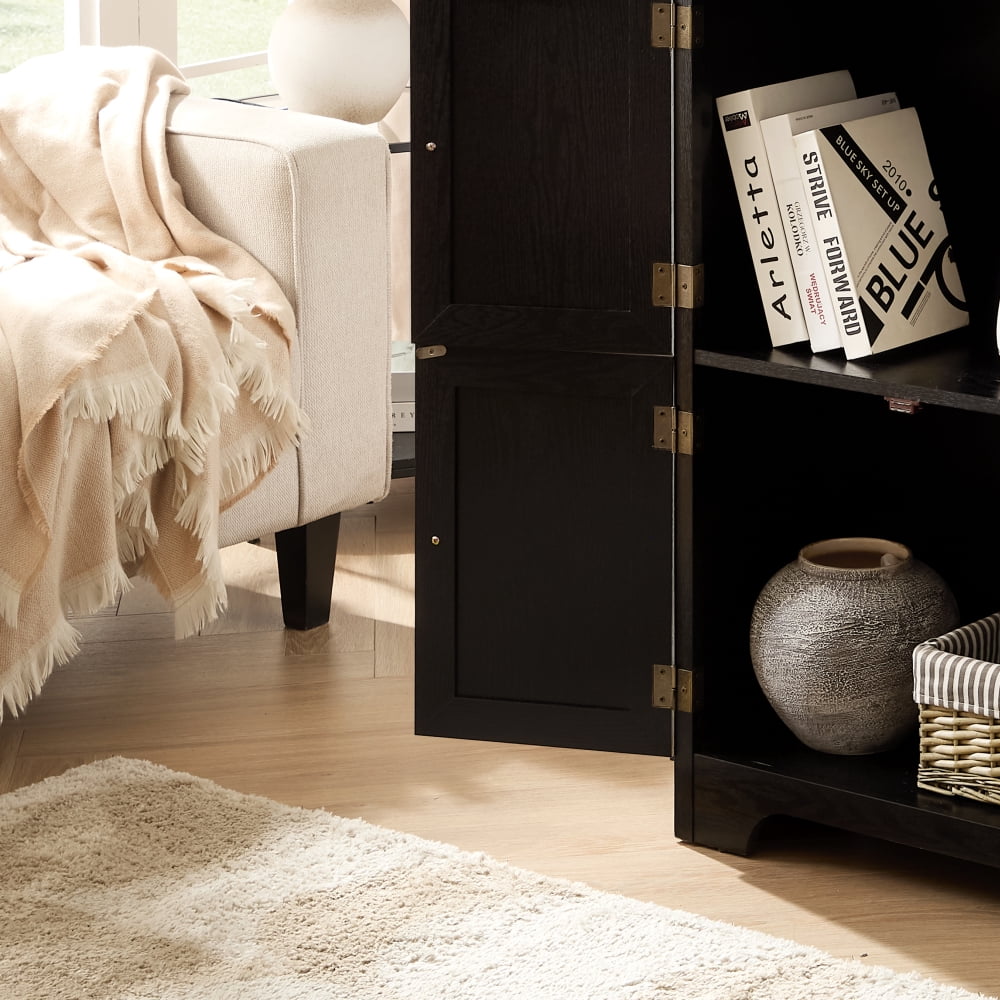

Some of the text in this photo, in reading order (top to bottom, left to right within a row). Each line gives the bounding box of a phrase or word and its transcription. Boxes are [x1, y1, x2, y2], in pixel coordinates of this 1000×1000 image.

[744, 156, 792, 320] Arletta
[835, 135, 901, 213] BLUE SKY SET UP
[802, 151, 833, 221] STRIVE
[823, 236, 862, 336] FORWARD
[865, 209, 935, 313] BLUE
